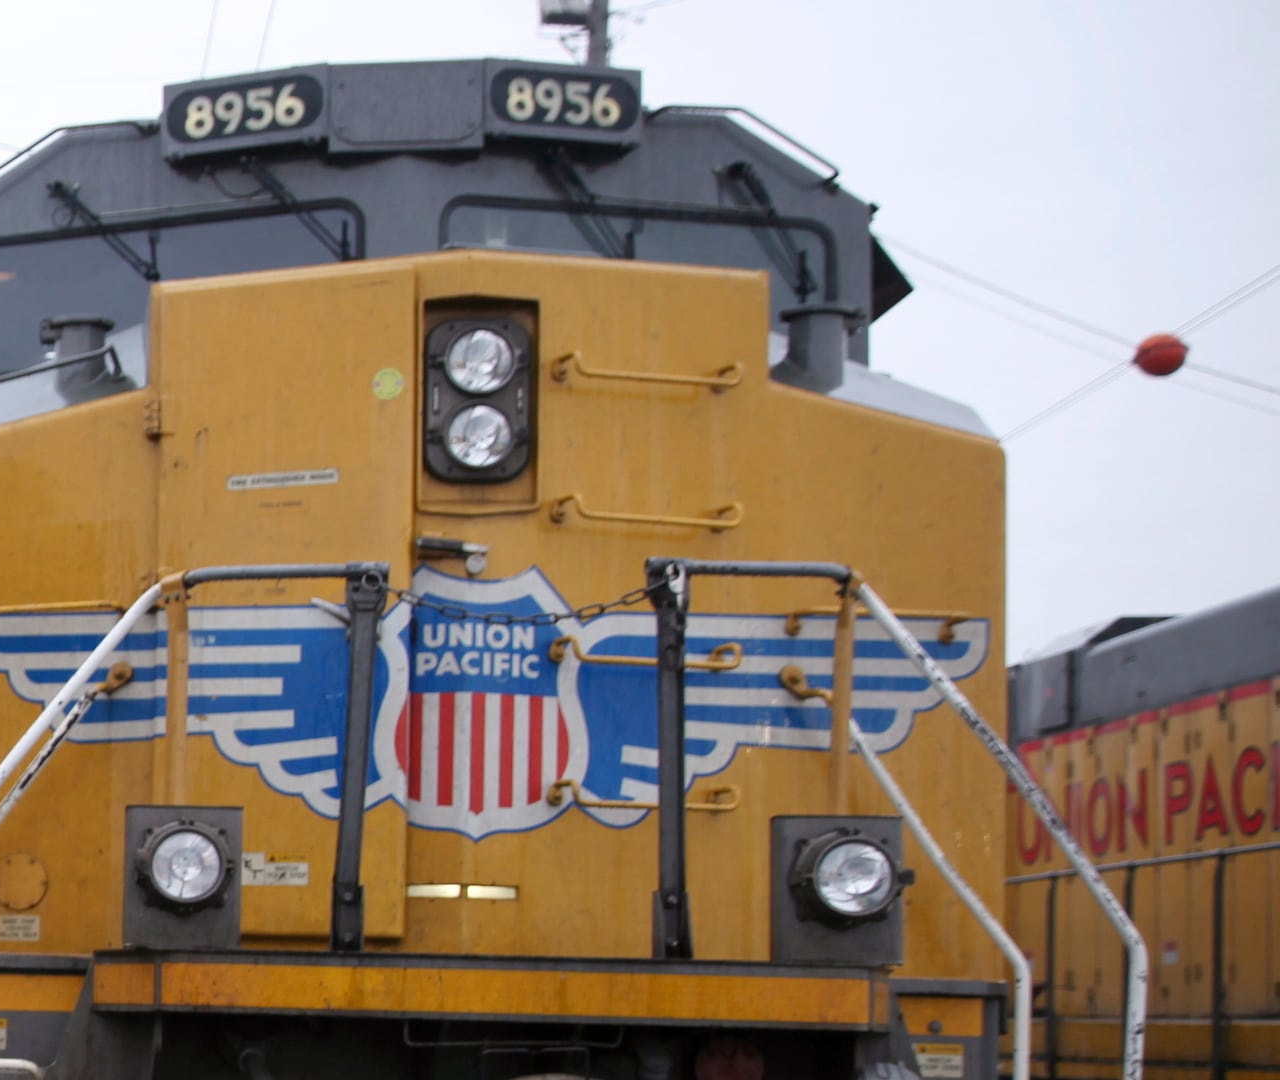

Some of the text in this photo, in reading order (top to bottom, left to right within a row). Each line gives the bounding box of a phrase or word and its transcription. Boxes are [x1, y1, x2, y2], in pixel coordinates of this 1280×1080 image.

[184, 83, 305, 139] 8956
[505, 77, 622, 128] 8956
[423, 622, 536, 650] UNION
[415, 651, 541, 679] PACIFIC
